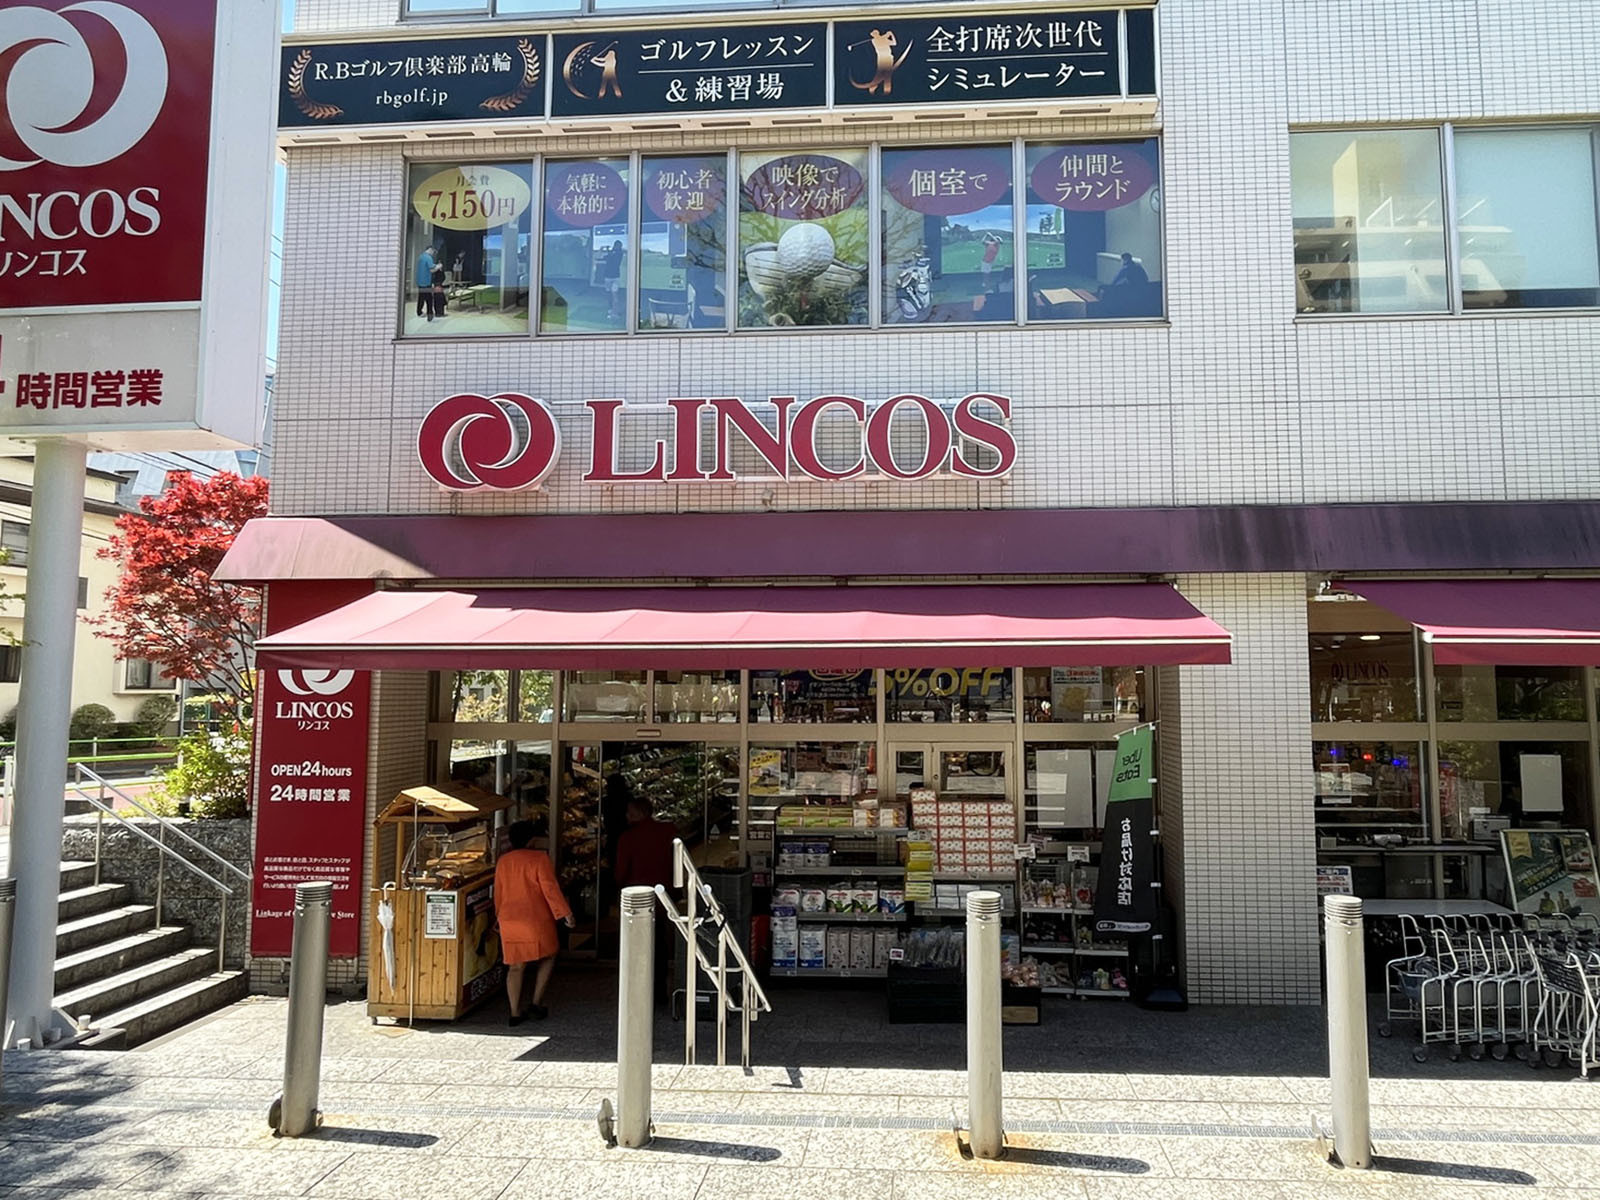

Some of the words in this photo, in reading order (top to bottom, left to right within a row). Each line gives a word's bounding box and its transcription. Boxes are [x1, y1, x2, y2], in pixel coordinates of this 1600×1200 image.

[639, 35, 814, 63] ゴルフレッスン
[926, 21, 1102, 53] 全打席次世代
[695, 73, 785, 102] 練習場
[927, 63, 1106, 90] シミュレーター
[375, 88, 448, 107] rbgolf.jp
[771, 164, 838, 187] 映像で
[1059, 153, 1124, 178] 仲間と
[566, 173, 607, 193] 気軽に
[656, 168, 713, 190] 初心者
[908, 168, 988, 197] 個室で
[1054, 178, 1131, 203] ラウンド
[427, 189, 516, 222] 7,150円
[558, 194, 615, 215] 本格的に
[663, 190, 705, 212] 歓迎
[762, 186, 847, 211] スイング分析
[583, 392, 1018, 482] LINCOS
[275, 701, 354, 720] LINCOS
[297, 720, 331, 731] リンコス
[270, 784, 351, 802] 24時間営業
